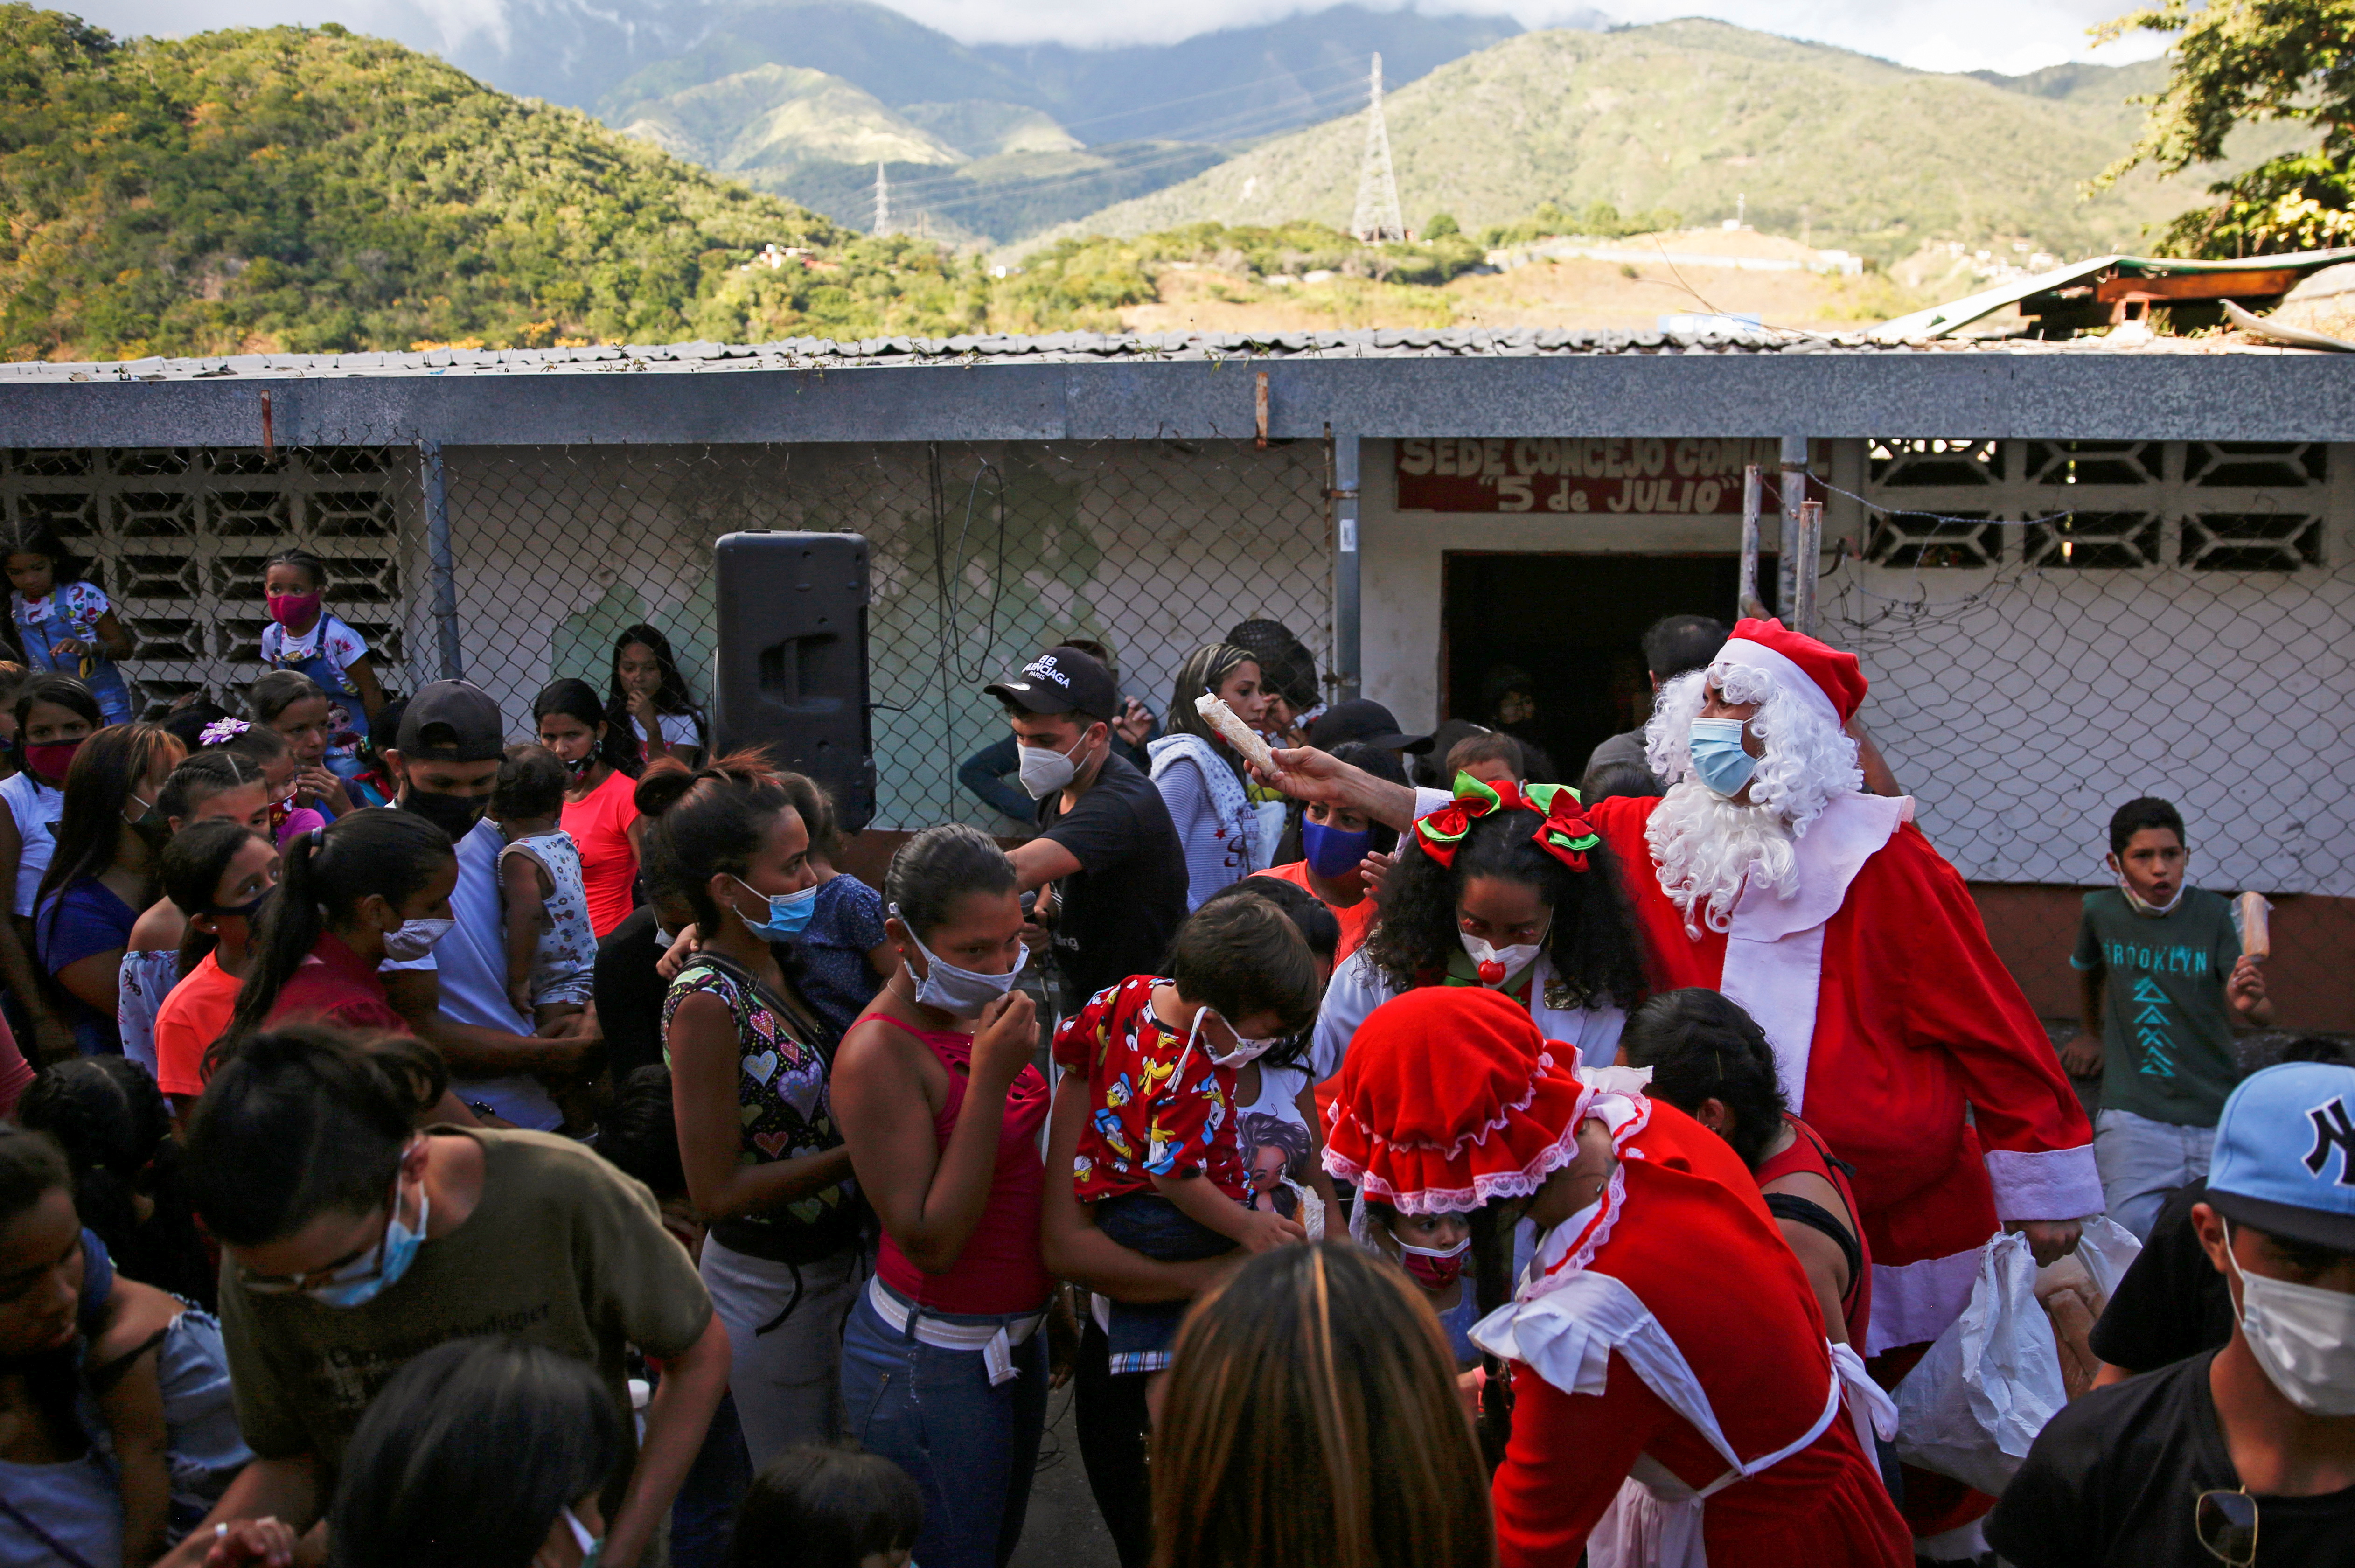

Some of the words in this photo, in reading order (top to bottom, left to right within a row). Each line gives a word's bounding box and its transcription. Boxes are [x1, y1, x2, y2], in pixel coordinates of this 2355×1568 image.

[1400, 438, 1506, 477] SEDE
[1514, 438, 1666, 477] CONCEJO
[1674, 438, 1830, 477] COMUNL
[1547, 478, 1589, 512] de
[1022, 662, 1070, 689] ALENCIAGA
[1028, 671, 1045, 680] PARIS
[2103, 939, 2207, 976] BROOKLYN
